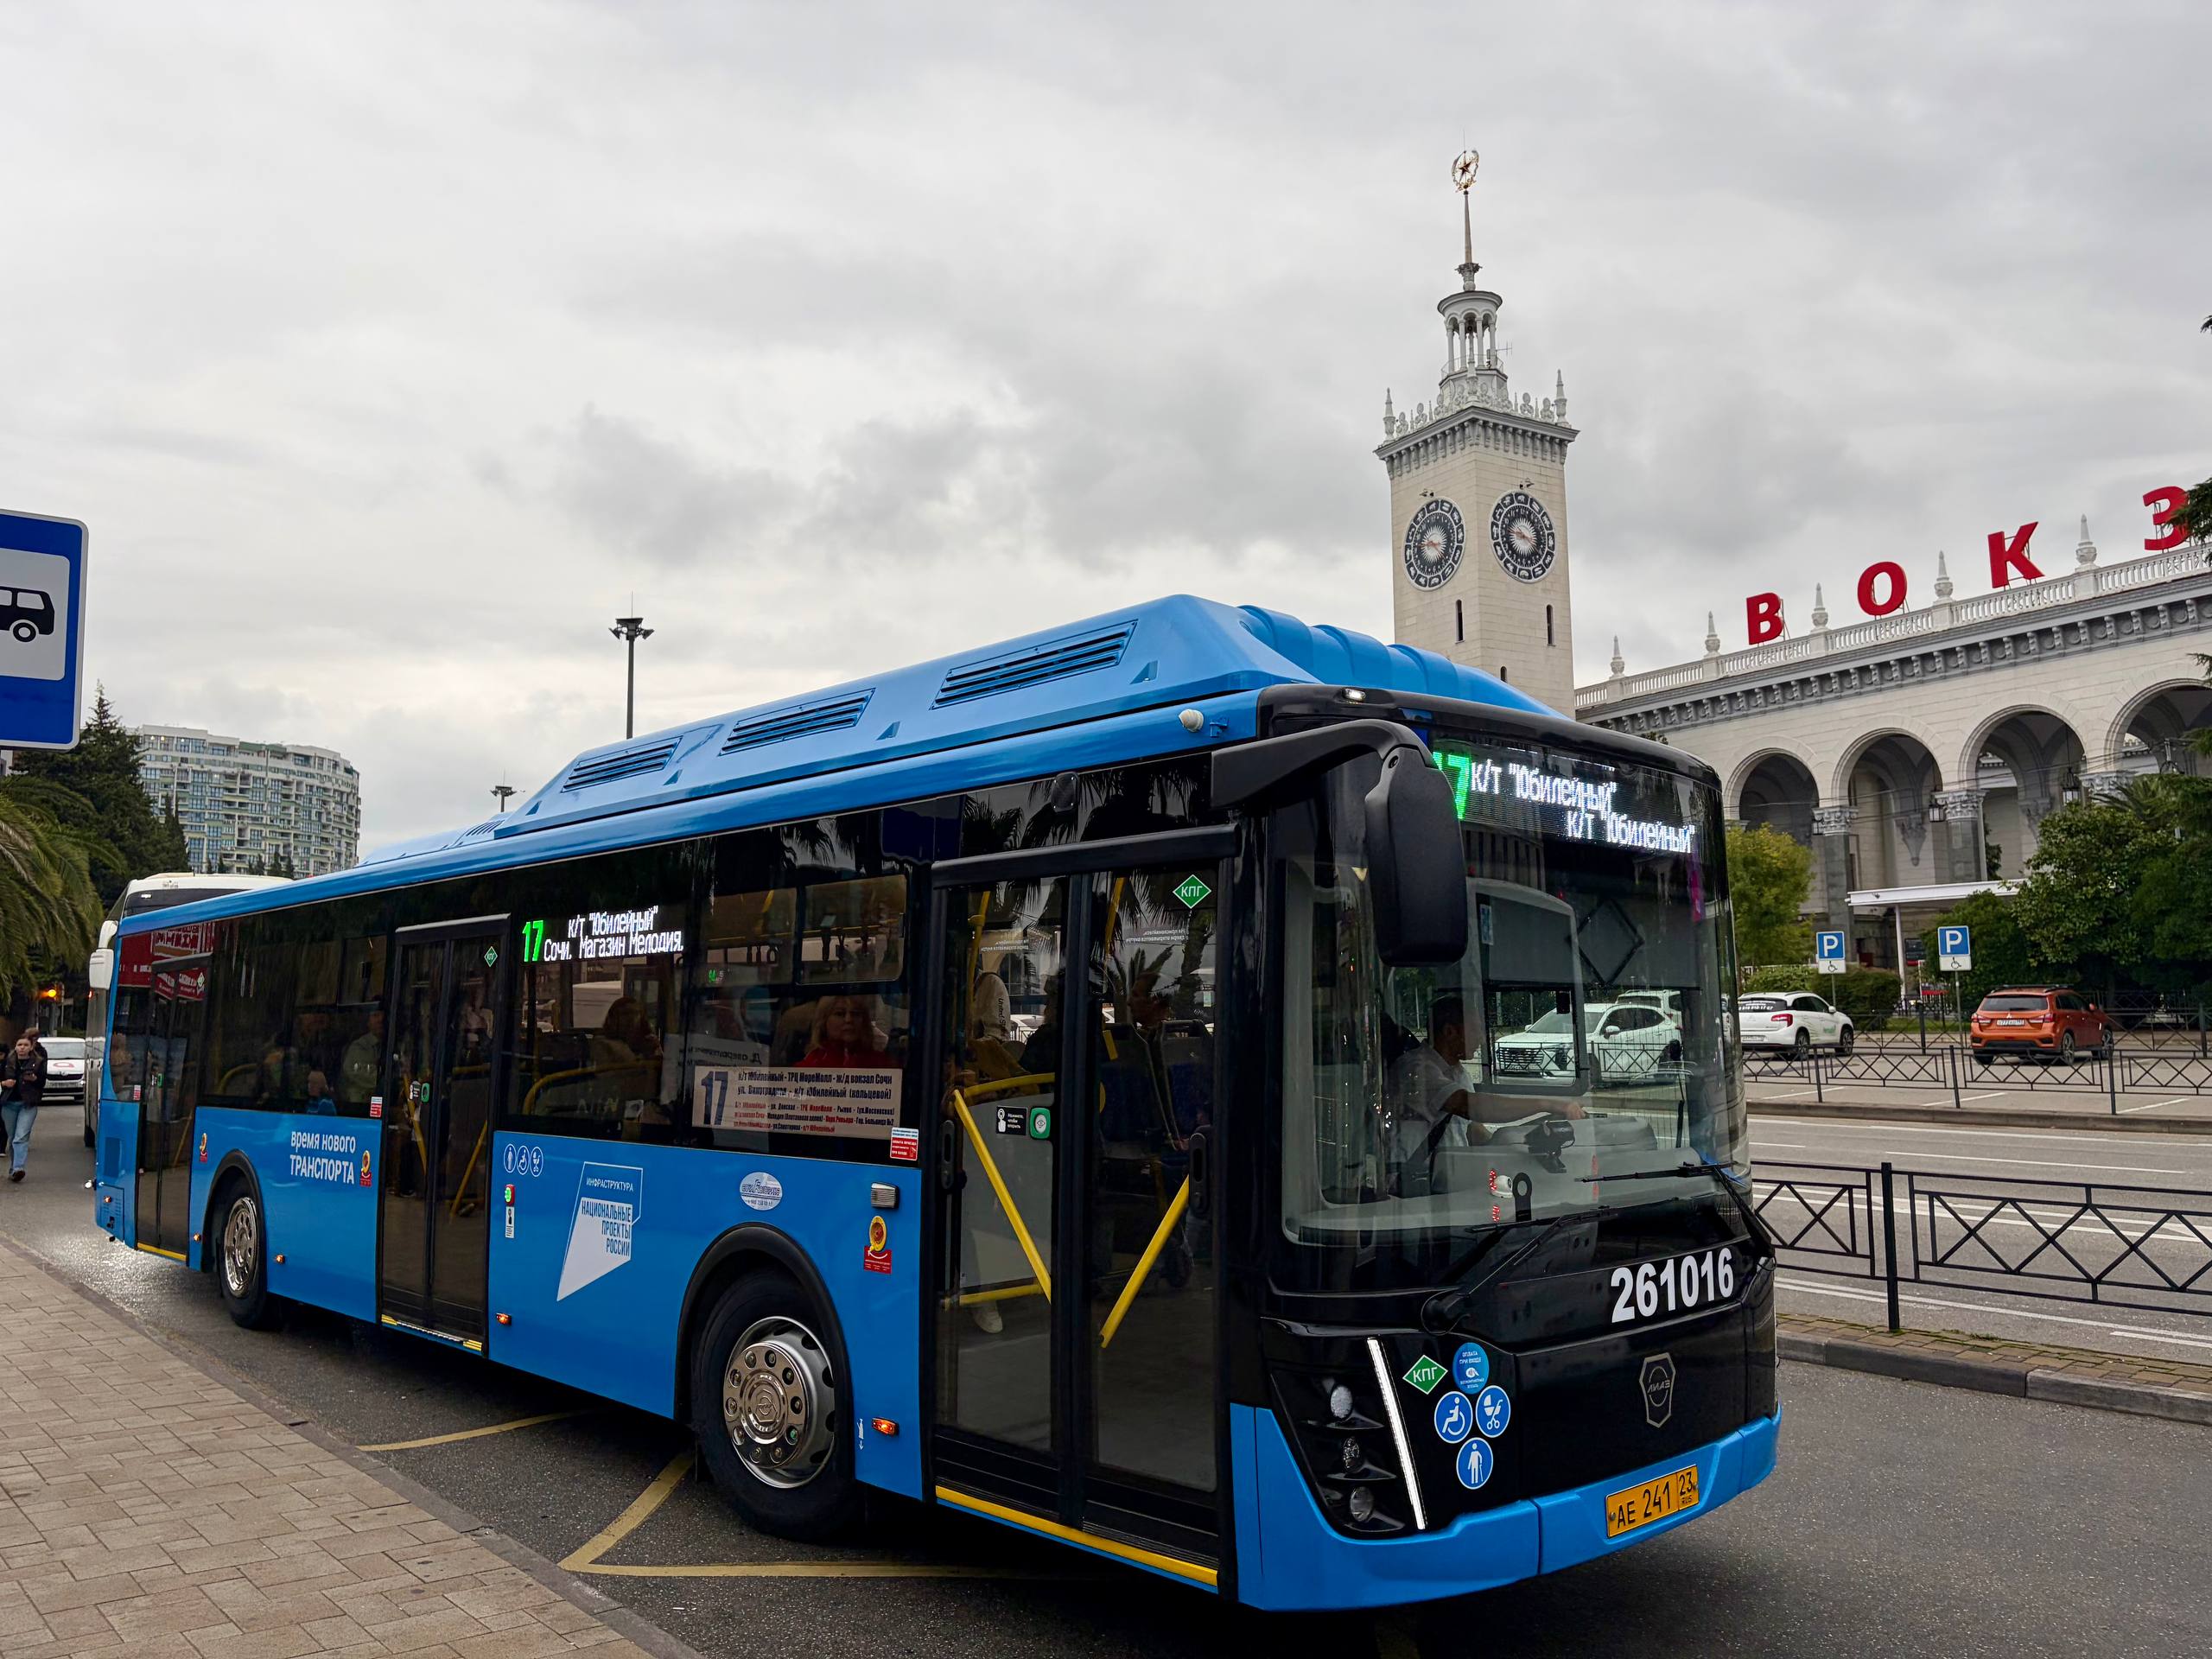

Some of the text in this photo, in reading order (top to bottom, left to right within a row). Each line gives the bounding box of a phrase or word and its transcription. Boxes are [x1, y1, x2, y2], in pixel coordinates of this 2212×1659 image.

[1180, 885, 1204, 899] КПГ
[589, 906, 658, 936] "Юбилейный"
[522, 919, 544, 962] 17
[543, 938, 571, 962] Сочи.
[579, 933, 626, 959] Магазин
[1822, 935, 1839, 957] P
[1946, 930, 1962, 953] P
[788, 1072, 798, 1083] ТРЦ
[850, 1075, 874, 1084] вокзал
[875, 1073, 893, 1084] Сочи
[701, 1071, 728, 1127] 17
[849, 1089, 892, 1099] (кольцевой)
[321, 1135, 356, 1154] нового
[289, 1154, 355, 1185] ТРАНСПОРТА
[586, 1177, 633, 1192] ИНФРАСТРУКТУРА
[582, 1200, 632, 1224] НАЦИОНАЛЬНЫЕ
[601, 1219, 631, 1239] ПРОЕКТЫ
[606, 1238, 630, 1256] РОССИИ
[1610, 1248, 1734, 1324] 261016
[1413, 1366, 1438, 1382] КПГ
[1642, 1484, 1671, 1519] 241
[1679, 1471, 1694, 1497] 23
[1681, 1495, 1693, 1505] RUS
